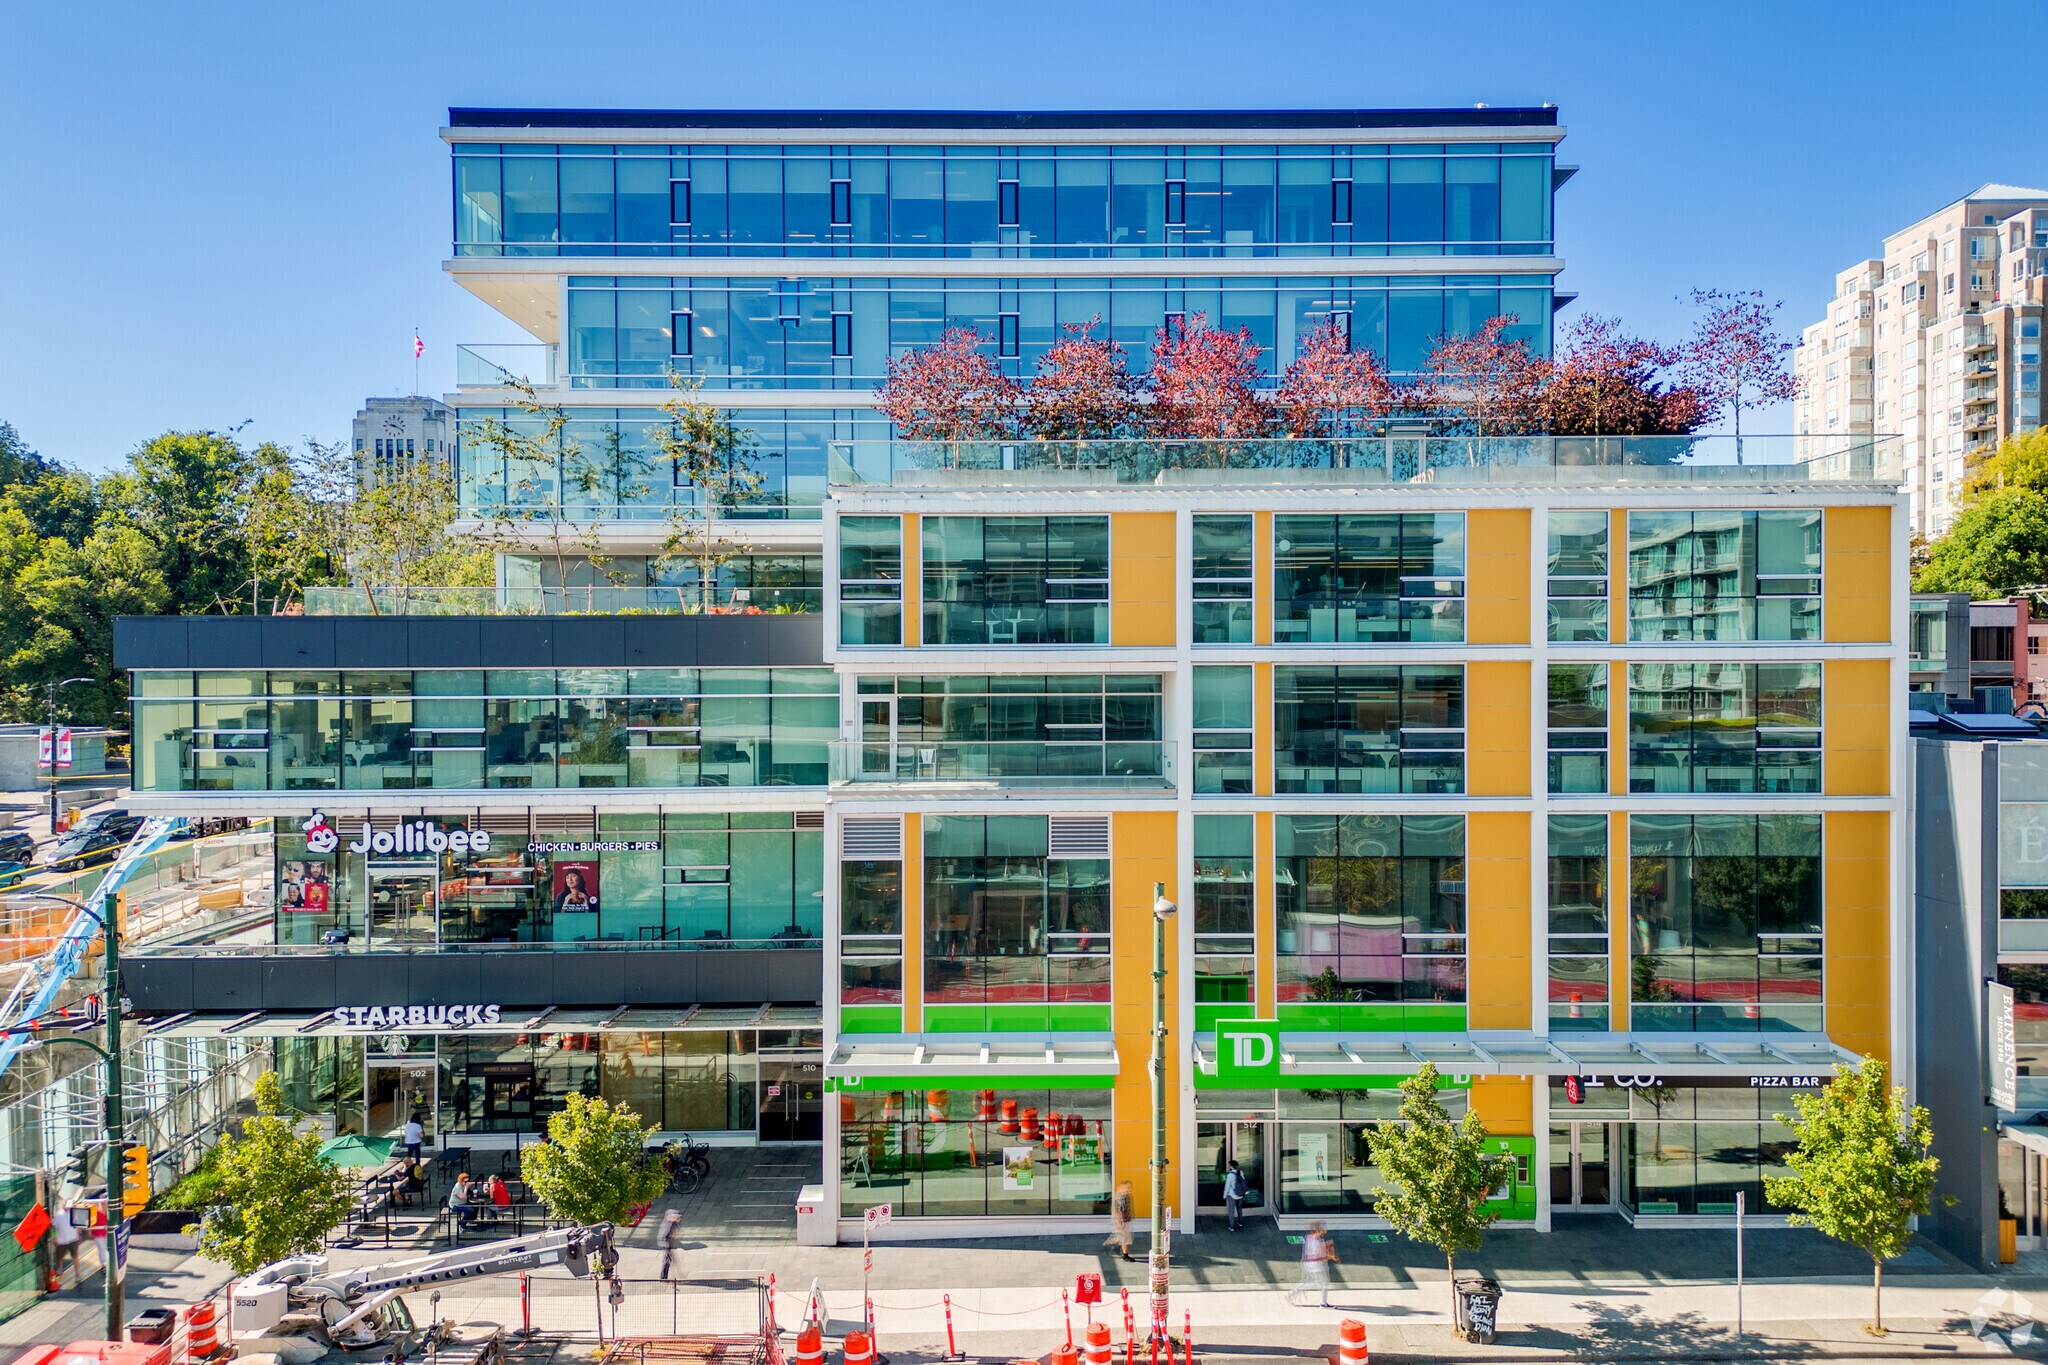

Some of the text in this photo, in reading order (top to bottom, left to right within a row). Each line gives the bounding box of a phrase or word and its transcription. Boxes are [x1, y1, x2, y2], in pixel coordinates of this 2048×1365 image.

[350, 820, 491, 853] Jollibee
[527, 842, 658, 852] CHICKEN BURGERS PIES
[334, 1004, 501, 1026] STARBUCKS
[1223, 1032, 1274, 1067] TD
[803, 1064, 817, 1072] 510
[410, 1070, 426, 1078] 502
[1750, 1077, 1819, 1087] PIZZA BAR
